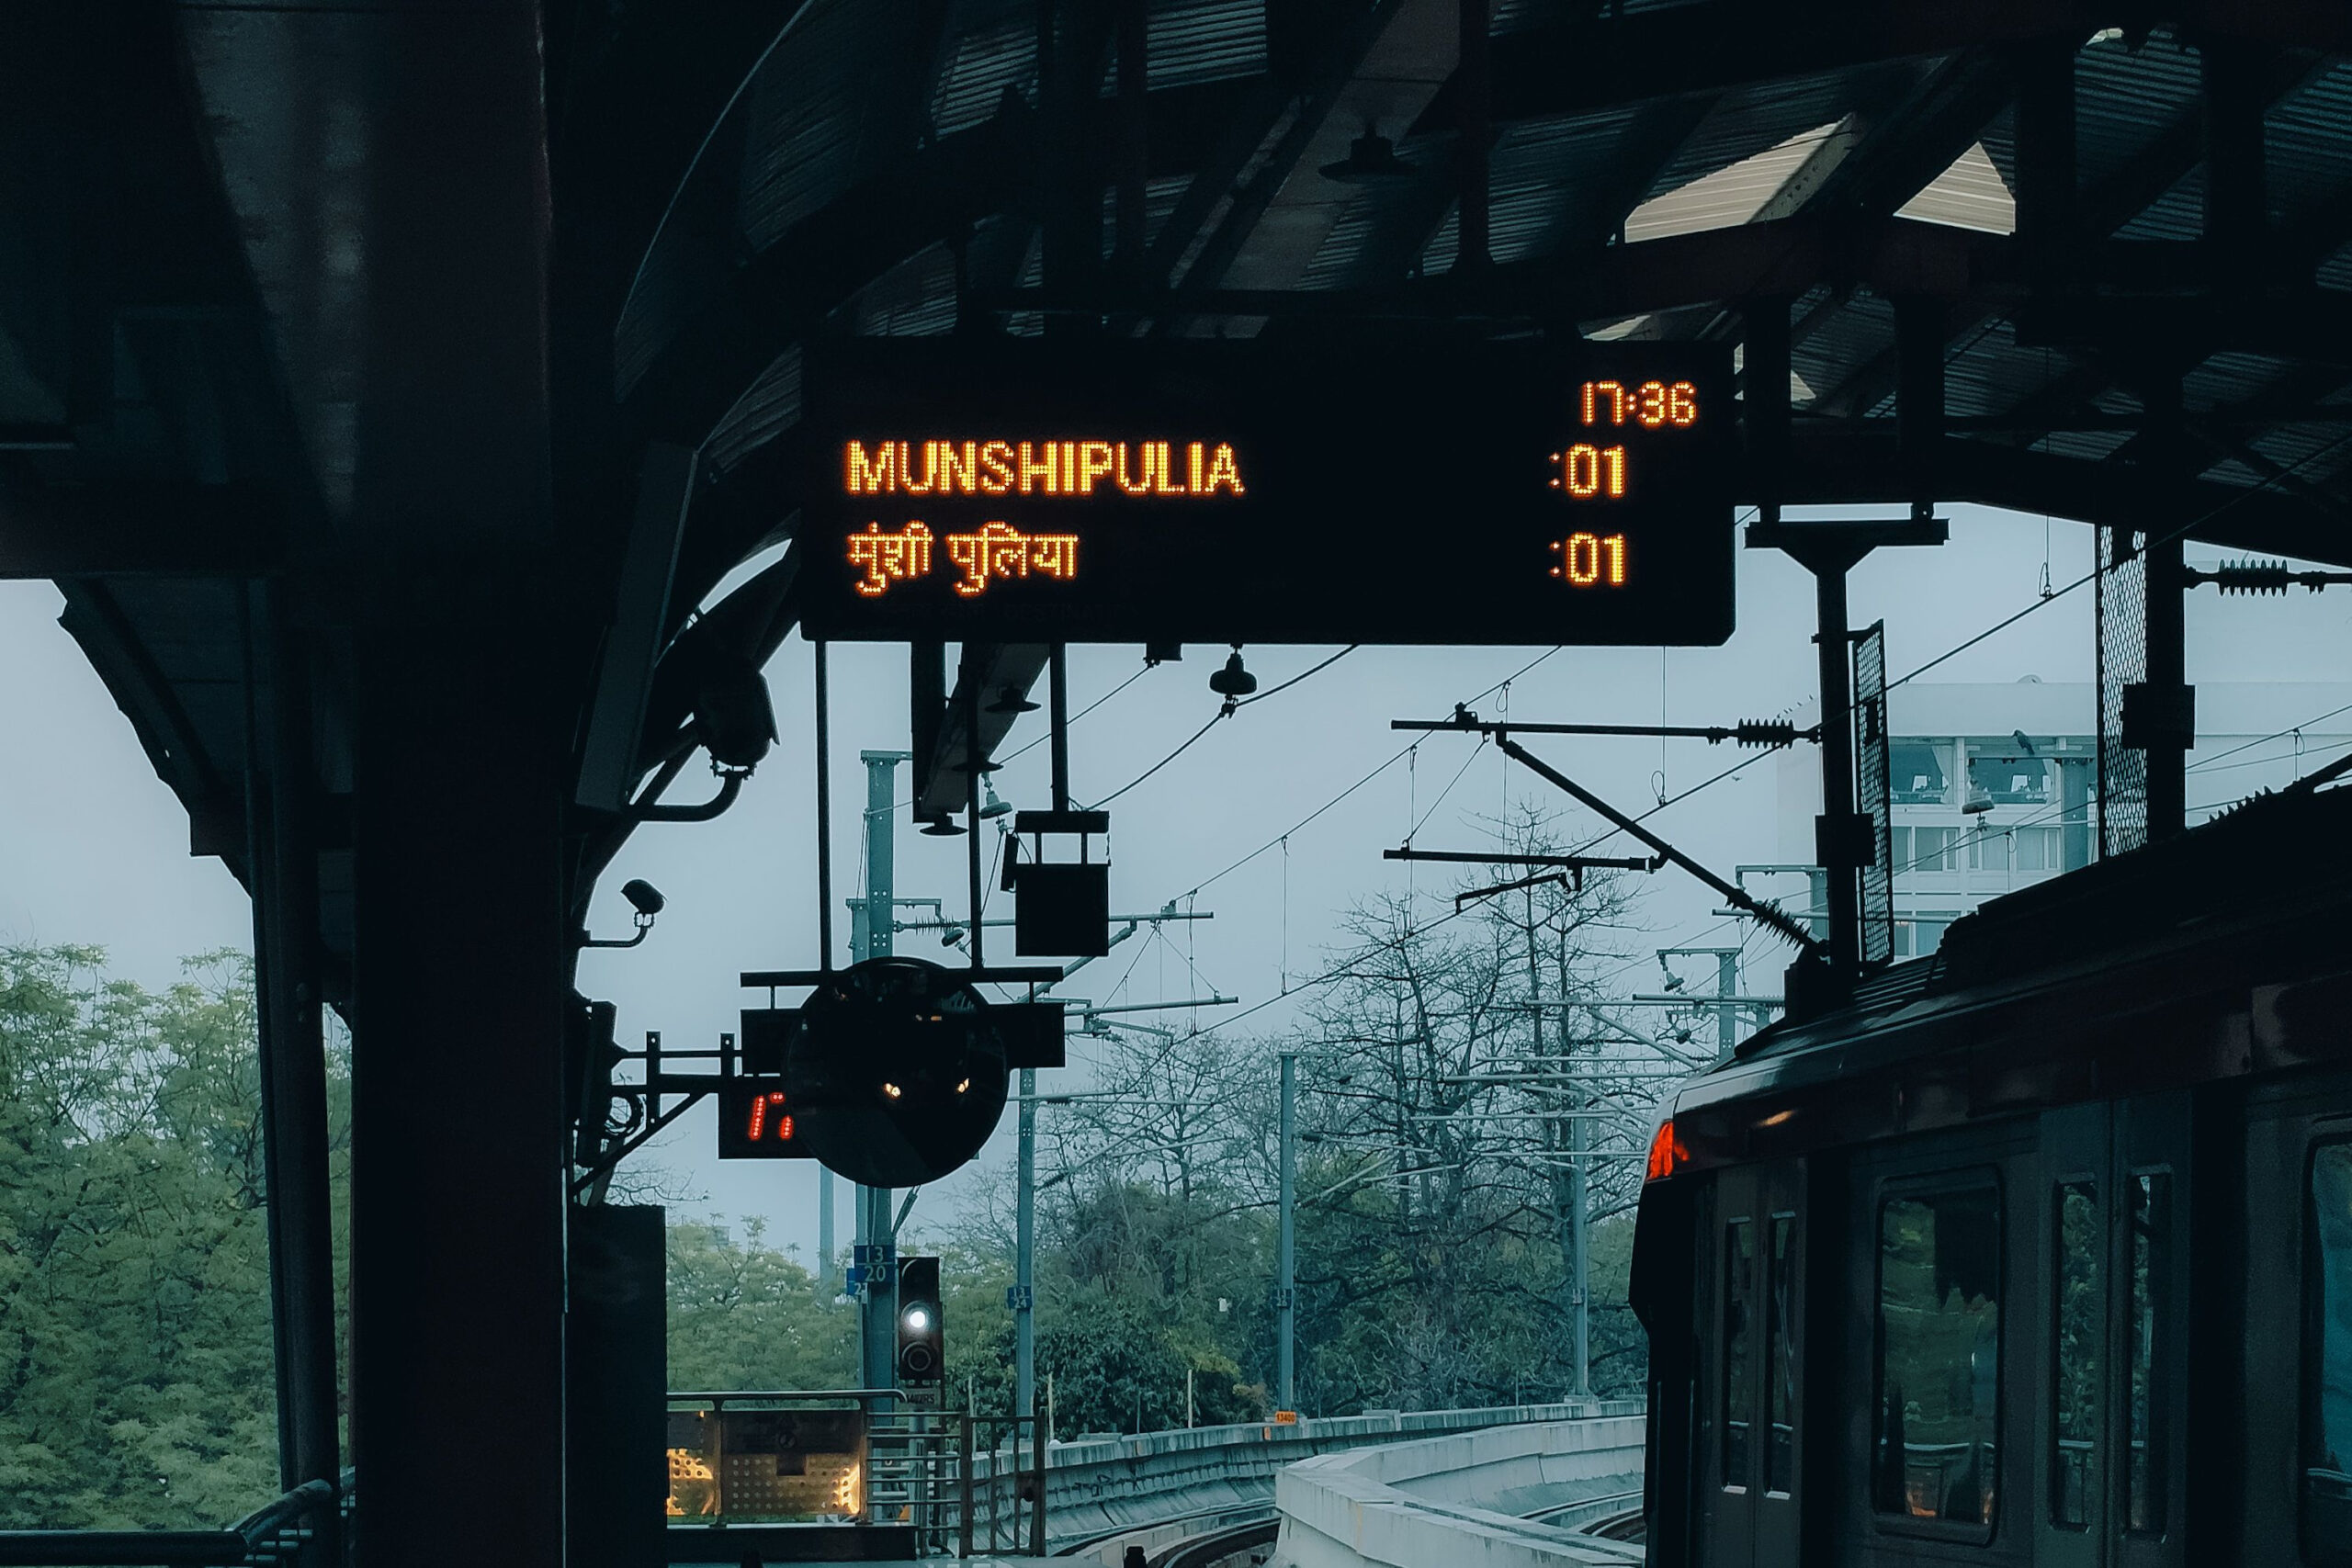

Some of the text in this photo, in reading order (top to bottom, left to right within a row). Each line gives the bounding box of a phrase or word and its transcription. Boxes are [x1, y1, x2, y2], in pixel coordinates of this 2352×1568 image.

[1582, 381, 1696, 427] 17:36
[845, 441, 1245, 495] MUNSHIPULIA
[846, 520, 934, 595] मुंशी
[944, 521, 1079, 595] पुलिया
[865, 1247, 884, 1263] 13
[865, 1265, 886, 1282] 20
[1013, 1287, 1025, 1298] 13
[1013, 1298, 1027, 1308] 24
